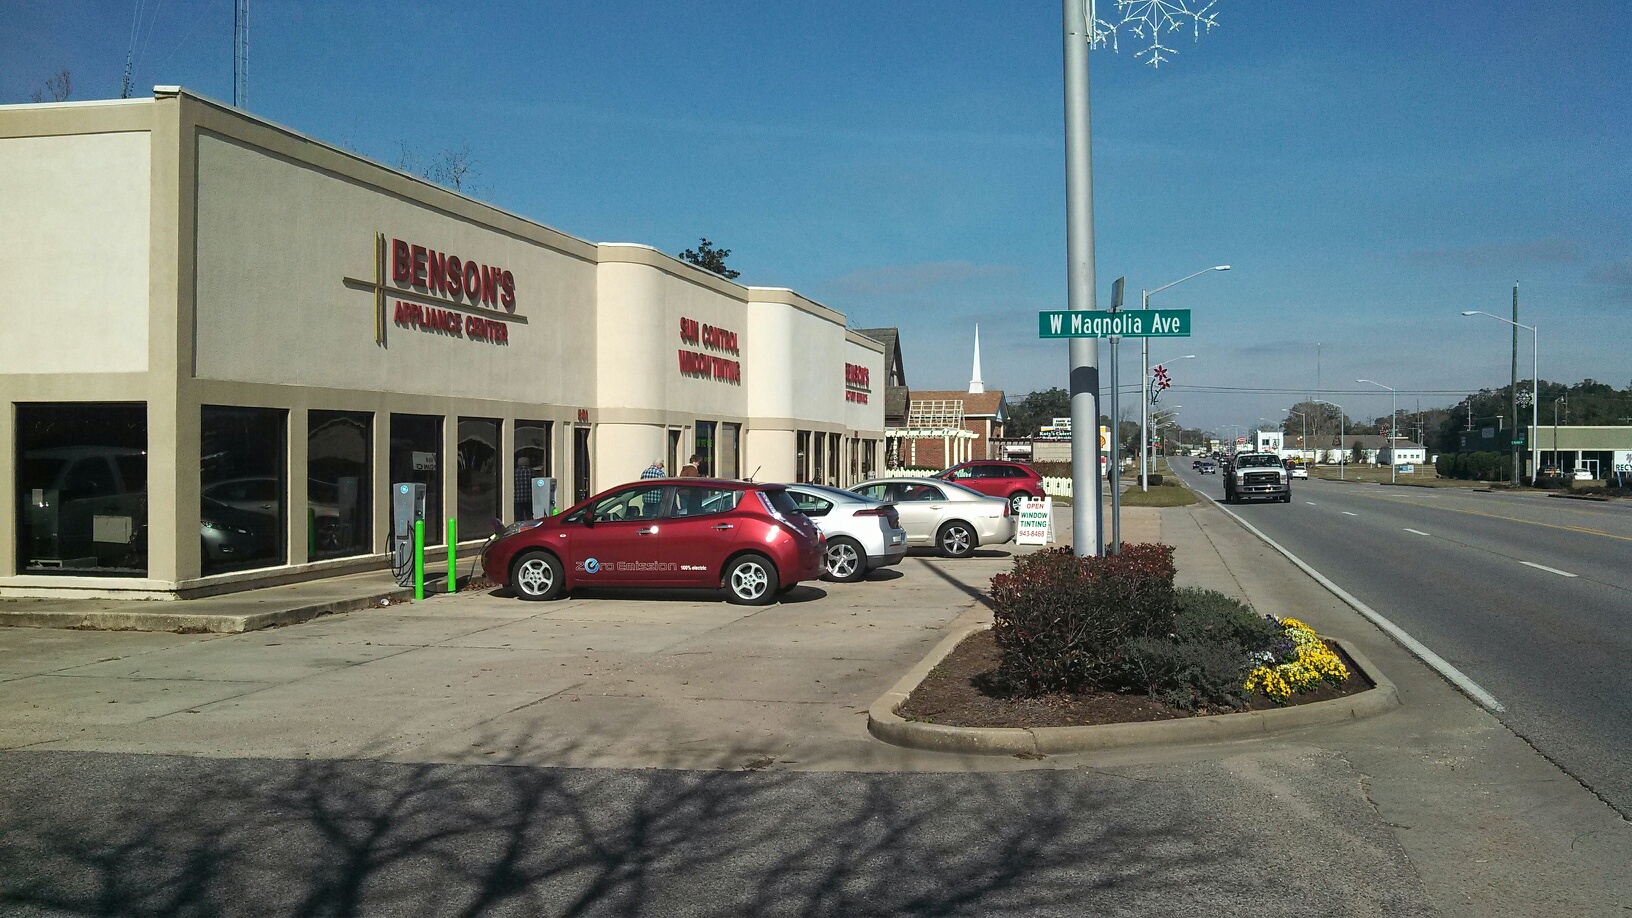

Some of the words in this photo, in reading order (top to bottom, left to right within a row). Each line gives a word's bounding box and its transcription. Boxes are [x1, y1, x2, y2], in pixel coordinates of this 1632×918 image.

[392, 238, 515, 309] BENSON'S
[393, 300, 463, 335] APPLIANCE
[464, 315, 509, 343] CENTER
[679, 316, 700, 343] SUN
[701, 323, 740, 355] CONTROL
[1049, 314, 1063, 335] W
[1071, 312, 1142, 338] Magnolia
[1151, 312, 1181, 334] Ave
[677, 349, 712, 377] WINDOW
[711, 356, 741, 384] TINTING
[1020, 511, 1048, 519] WINDOW
[1020, 520, 1047, 528] TINTING
[616, 560, 678, 572] Emission
